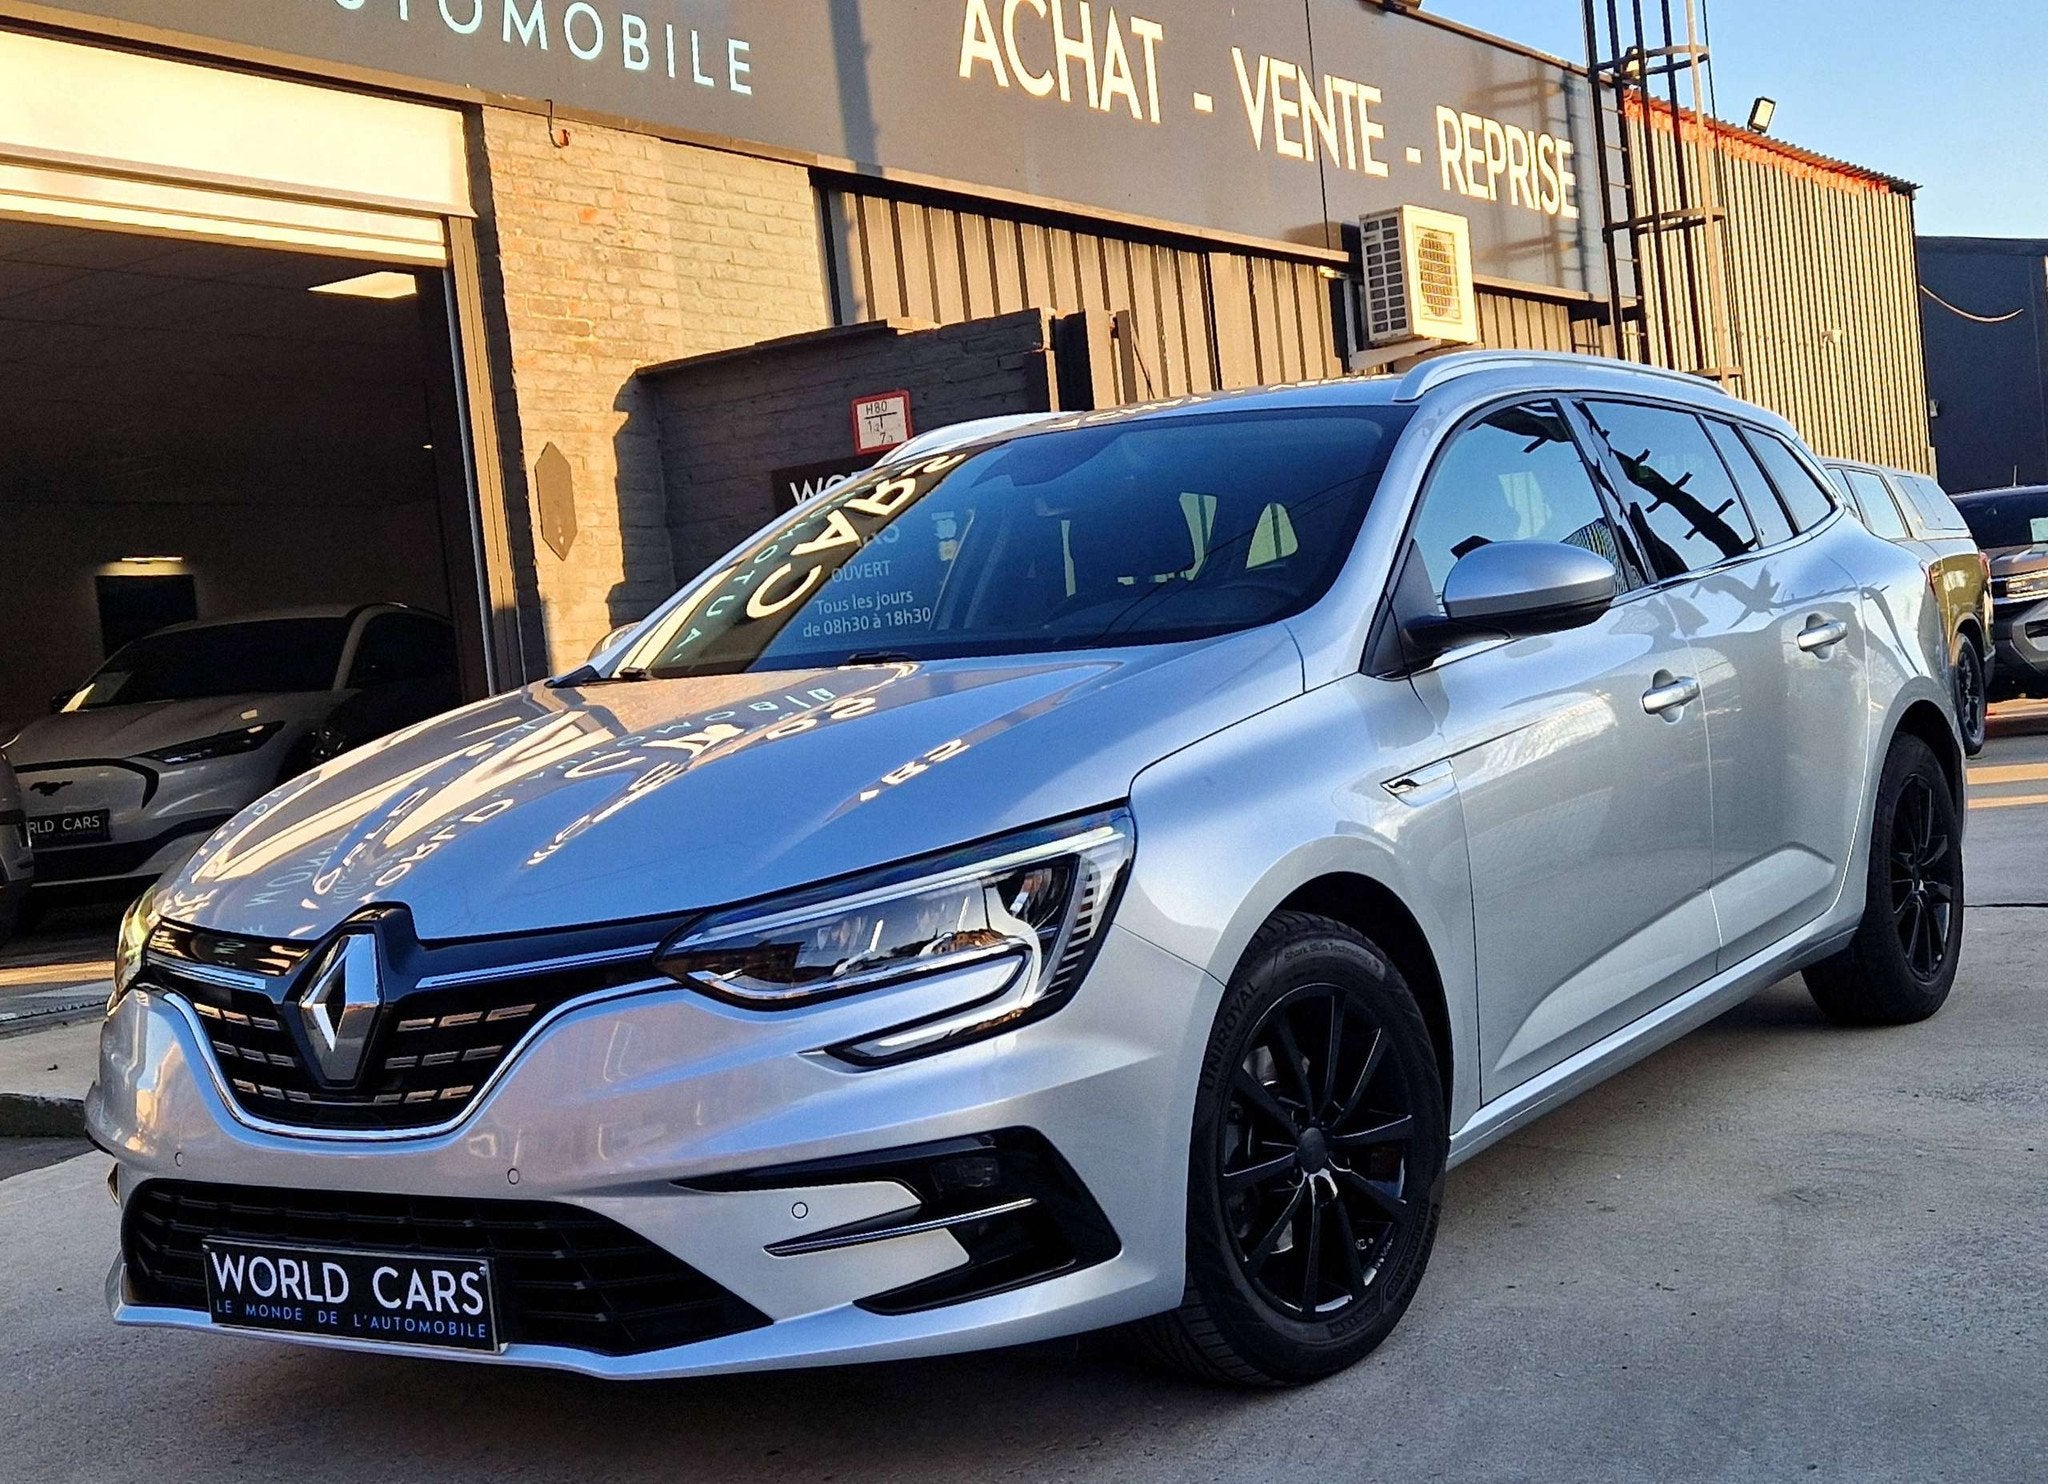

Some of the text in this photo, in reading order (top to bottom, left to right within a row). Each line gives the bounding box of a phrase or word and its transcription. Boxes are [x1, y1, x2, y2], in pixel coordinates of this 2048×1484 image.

[333, 0, 753, 96] OMOBILE
[959, 0, 1163, 124] ACHAT
[1231, 46, 1389, 178] VENTE
[1436, 105, 1580, 220] REPRISE
[865, 401, 888, 415] H80
[832, 560, 891, 583] OUVERT
[815, 590, 914, 615] Tous les jours
[803, 606, 932, 638] de 08h30 à 18h30
[62, 815, 100, 831] CARS
[1203, 980, 1261, 1091] UNIROYAL
[210, 1251, 484, 1316] WORLD CARS
[216, 1299, 487, 1339] LE MONDE DE L'AUTOMOBILE
